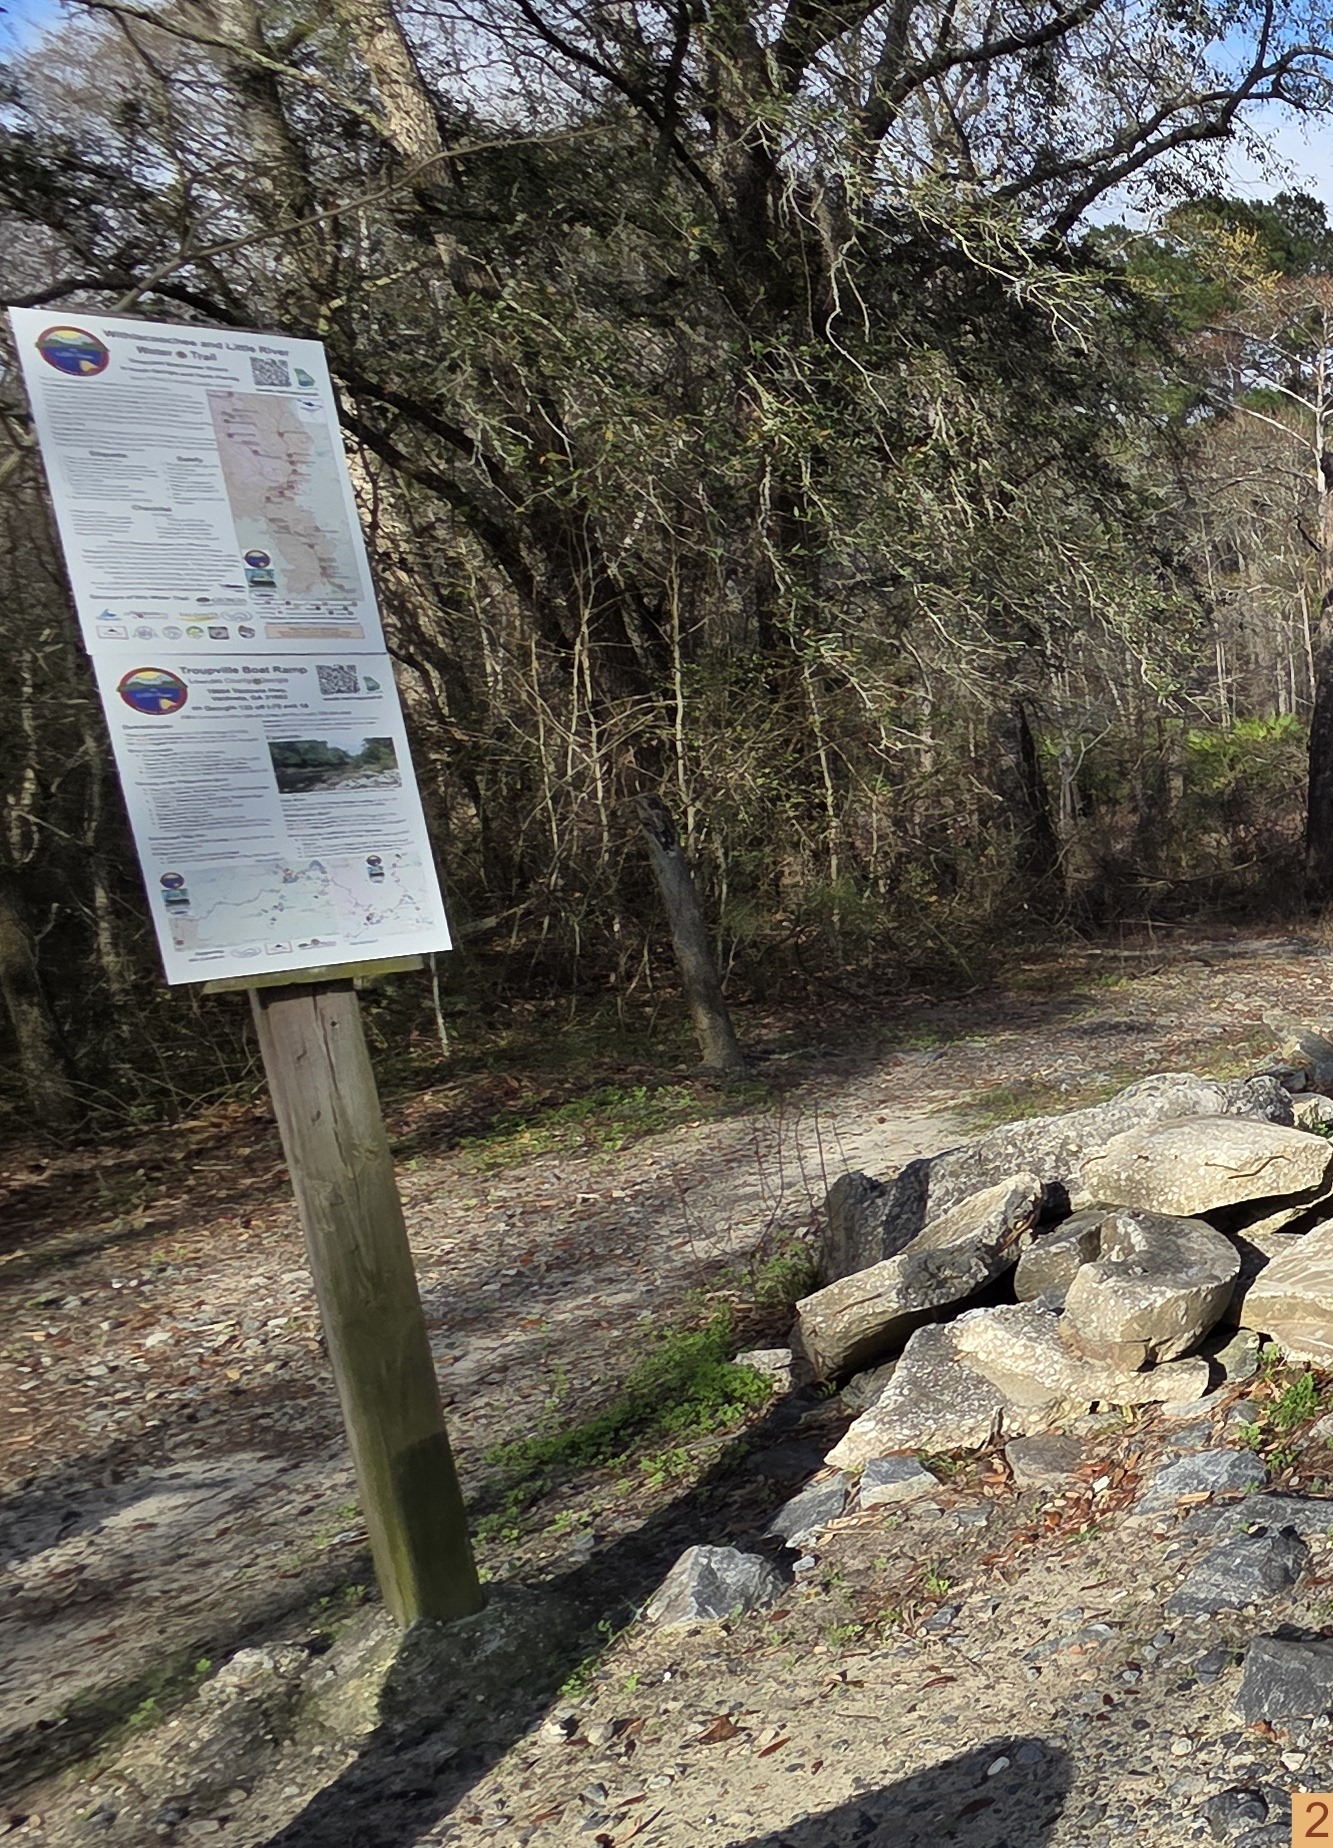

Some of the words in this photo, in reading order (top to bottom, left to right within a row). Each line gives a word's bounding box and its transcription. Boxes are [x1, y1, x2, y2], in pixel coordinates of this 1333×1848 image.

[179, 666, 239, 676] Troupville
[242, 666, 270, 674] Boat
[273, 666, 308, 675] Ramp
